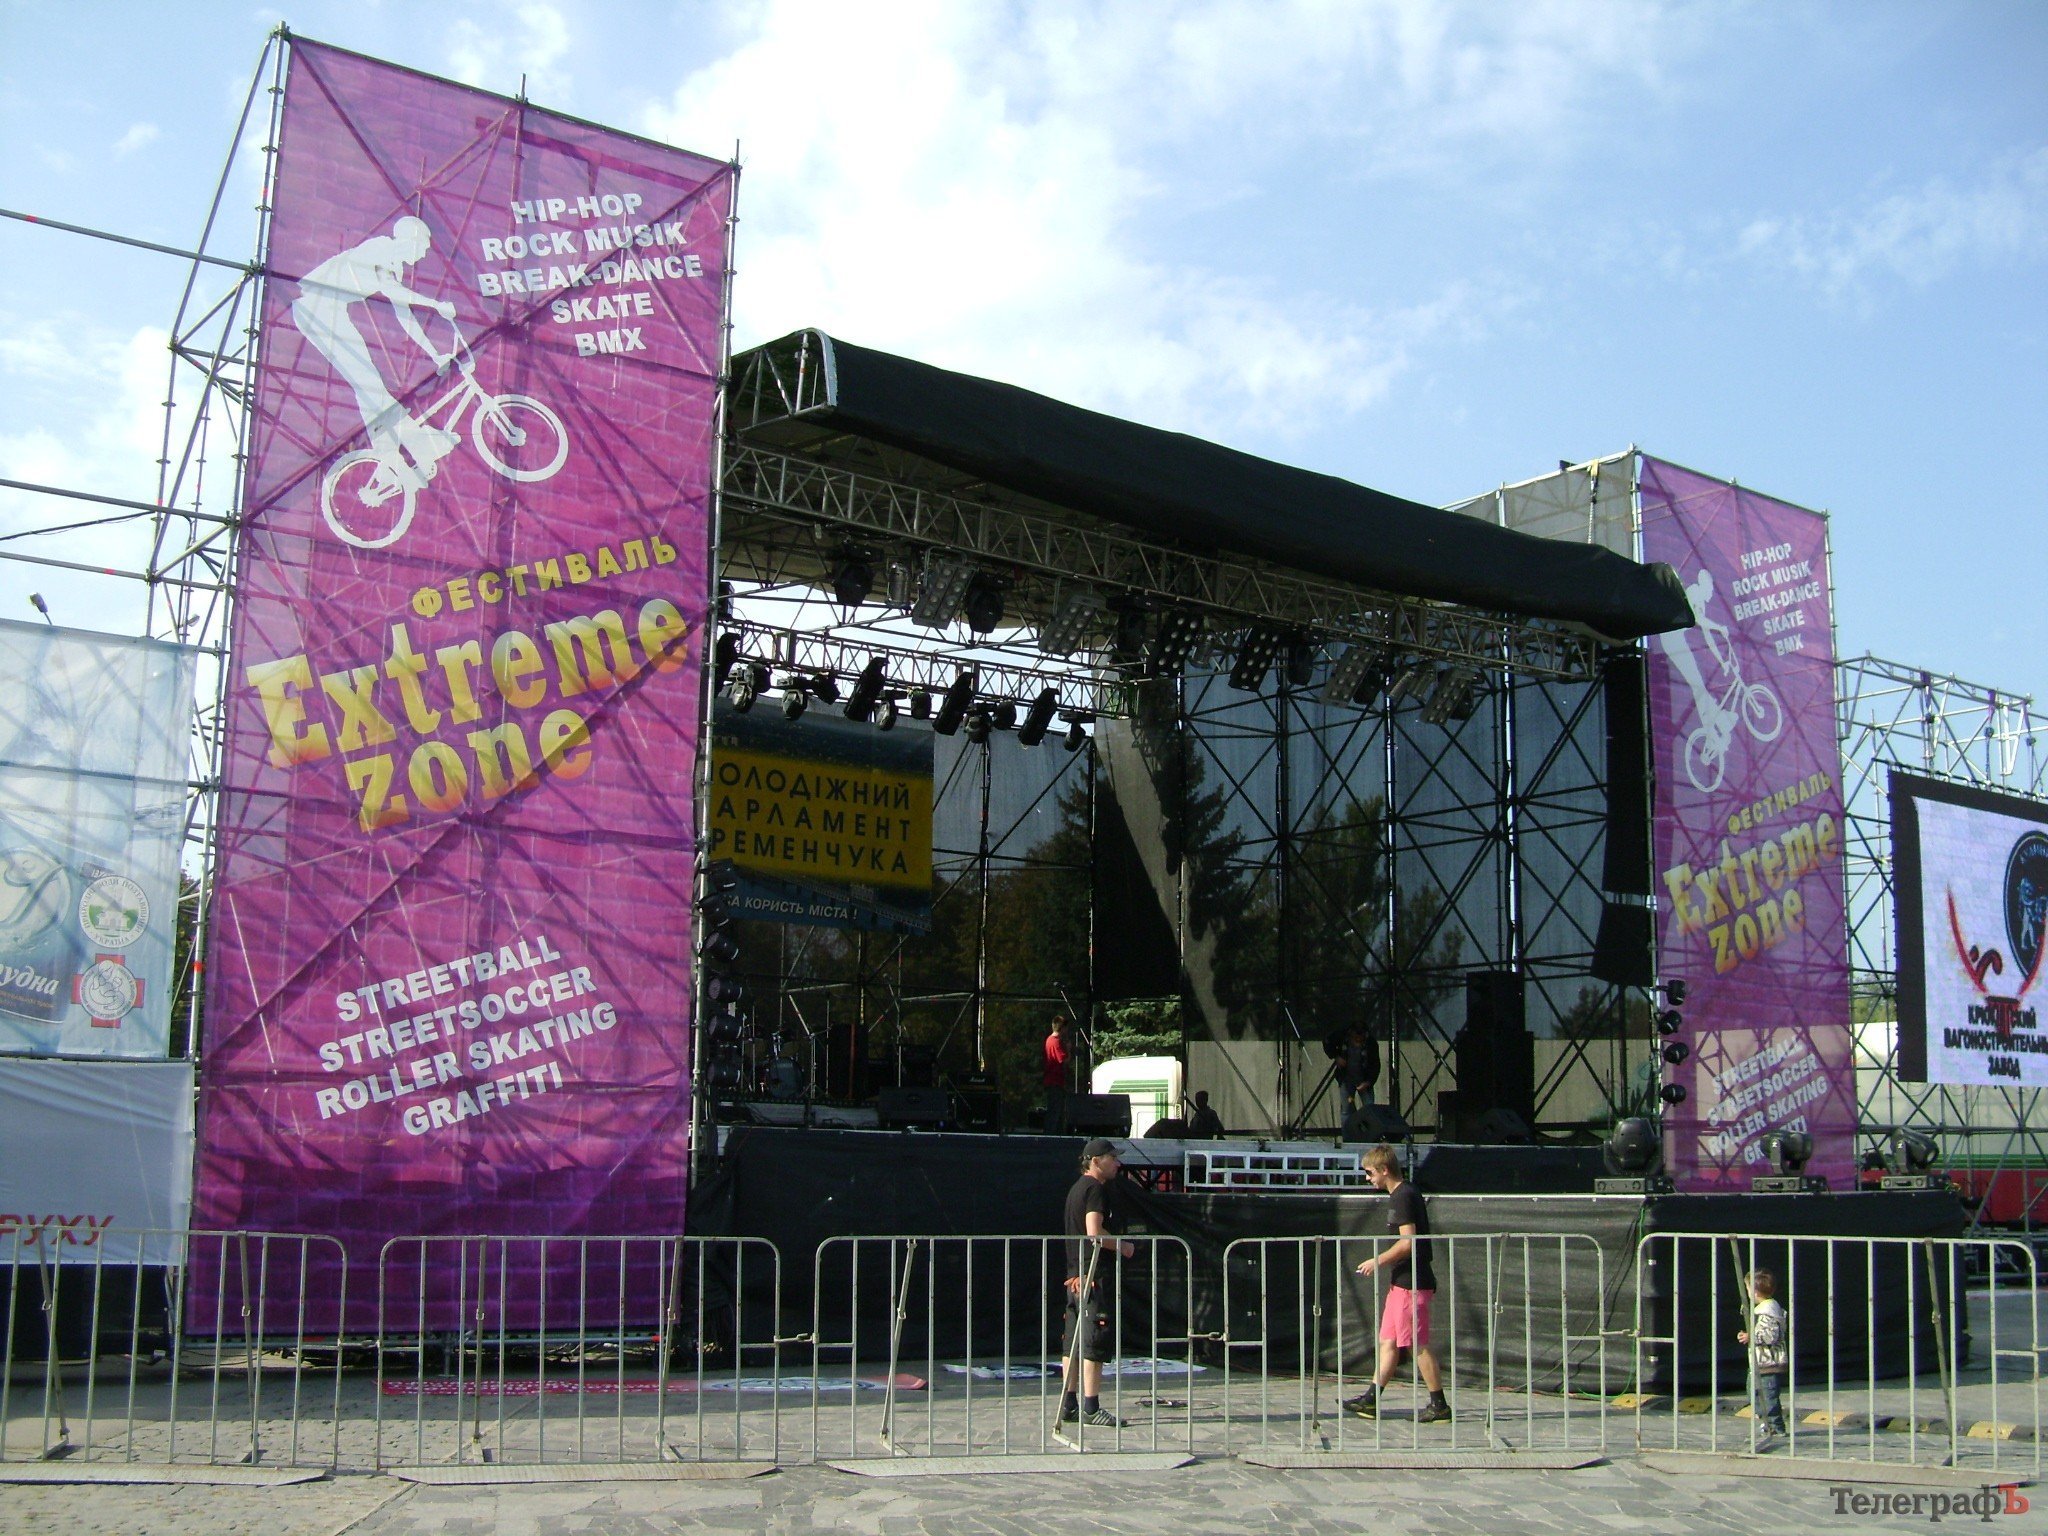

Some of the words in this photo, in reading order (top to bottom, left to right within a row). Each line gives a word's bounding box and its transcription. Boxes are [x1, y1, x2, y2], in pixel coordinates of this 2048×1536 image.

[511, 193, 642, 224] HIP-HOP
[481, 231, 577, 262] ROCK
[583, 222, 688, 251] MUSIK
[477, 254, 704, 297] BREAK-DANCE
[551, 292, 655, 324] SKATE
[575, 327, 647, 357] BMX
[411, 536, 677, 619] ФЕСТИВАЛЬ
[1732, 572, 1770, 597] ROCK
[1771, 560, 1812, 586] MUSIK
[1741, 543, 1792, 570] HIP-HOP
[1734, 581, 1821, 621] BREAK-DANCE
[1763, 610, 1805, 635] SKATE
[1775, 634, 1804, 656] BMX
[246, 598, 688, 769] Extreme
[711, 761, 909, 810] ОЛОДІЖНИЙ
[1728, 771, 1831, 835] ФЕСТИВАЛЬ
[716, 796, 910, 842] АРЛАМЕНТ
[709, 827, 908, 874] РЕМЕНЧУКА
[1663, 813, 1838, 937] Extreme
[745, 898, 804, 915] КОРИСТЬ
[808, 904, 848, 920] МІСТА
[336, 935, 560, 1021] STREETBALL
[319, 966, 597, 1072] STREETSOCCER
[316, 1052, 463, 1119] ROLLER
[468, 1002, 617, 1070] SKATING
[1712, 1036, 1806, 1095] STREETBALL
[403, 1061, 564, 1136] GRAFFITI
[1707, 1053, 1818, 1126] STREETSOCCER
[1709, 1111, 1767, 1156] ROLLER
[1768, 1076, 1828, 1123] SKATING
